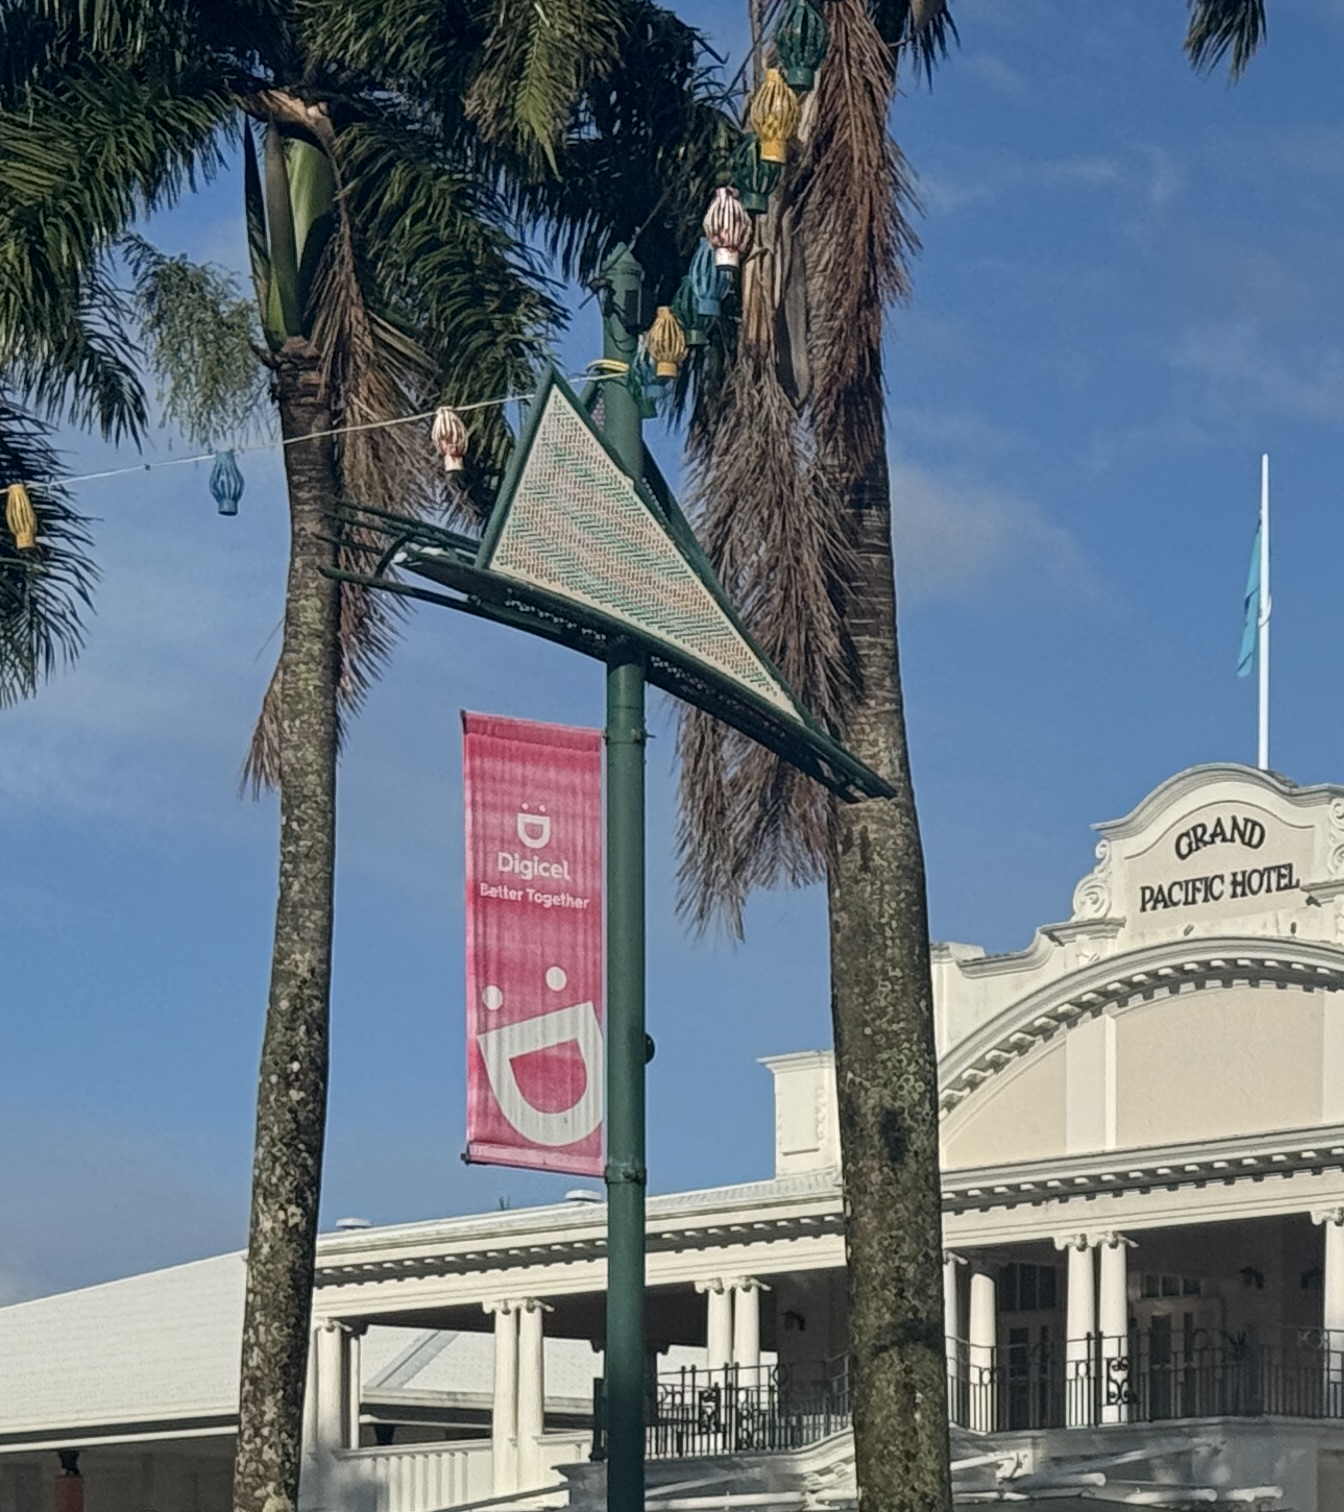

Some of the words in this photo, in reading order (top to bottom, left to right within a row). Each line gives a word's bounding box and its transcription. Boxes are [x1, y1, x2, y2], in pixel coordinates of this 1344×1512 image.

[1174, 815, 1266, 861] GRAND
[497, 851, 572, 881] Digicel
[479, 882, 524, 902] Better
[526, 887, 590, 909] Together
[1139, 874, 1225, 913] PACIFIC
[1229, 862, 1301, 899] HOTEL
